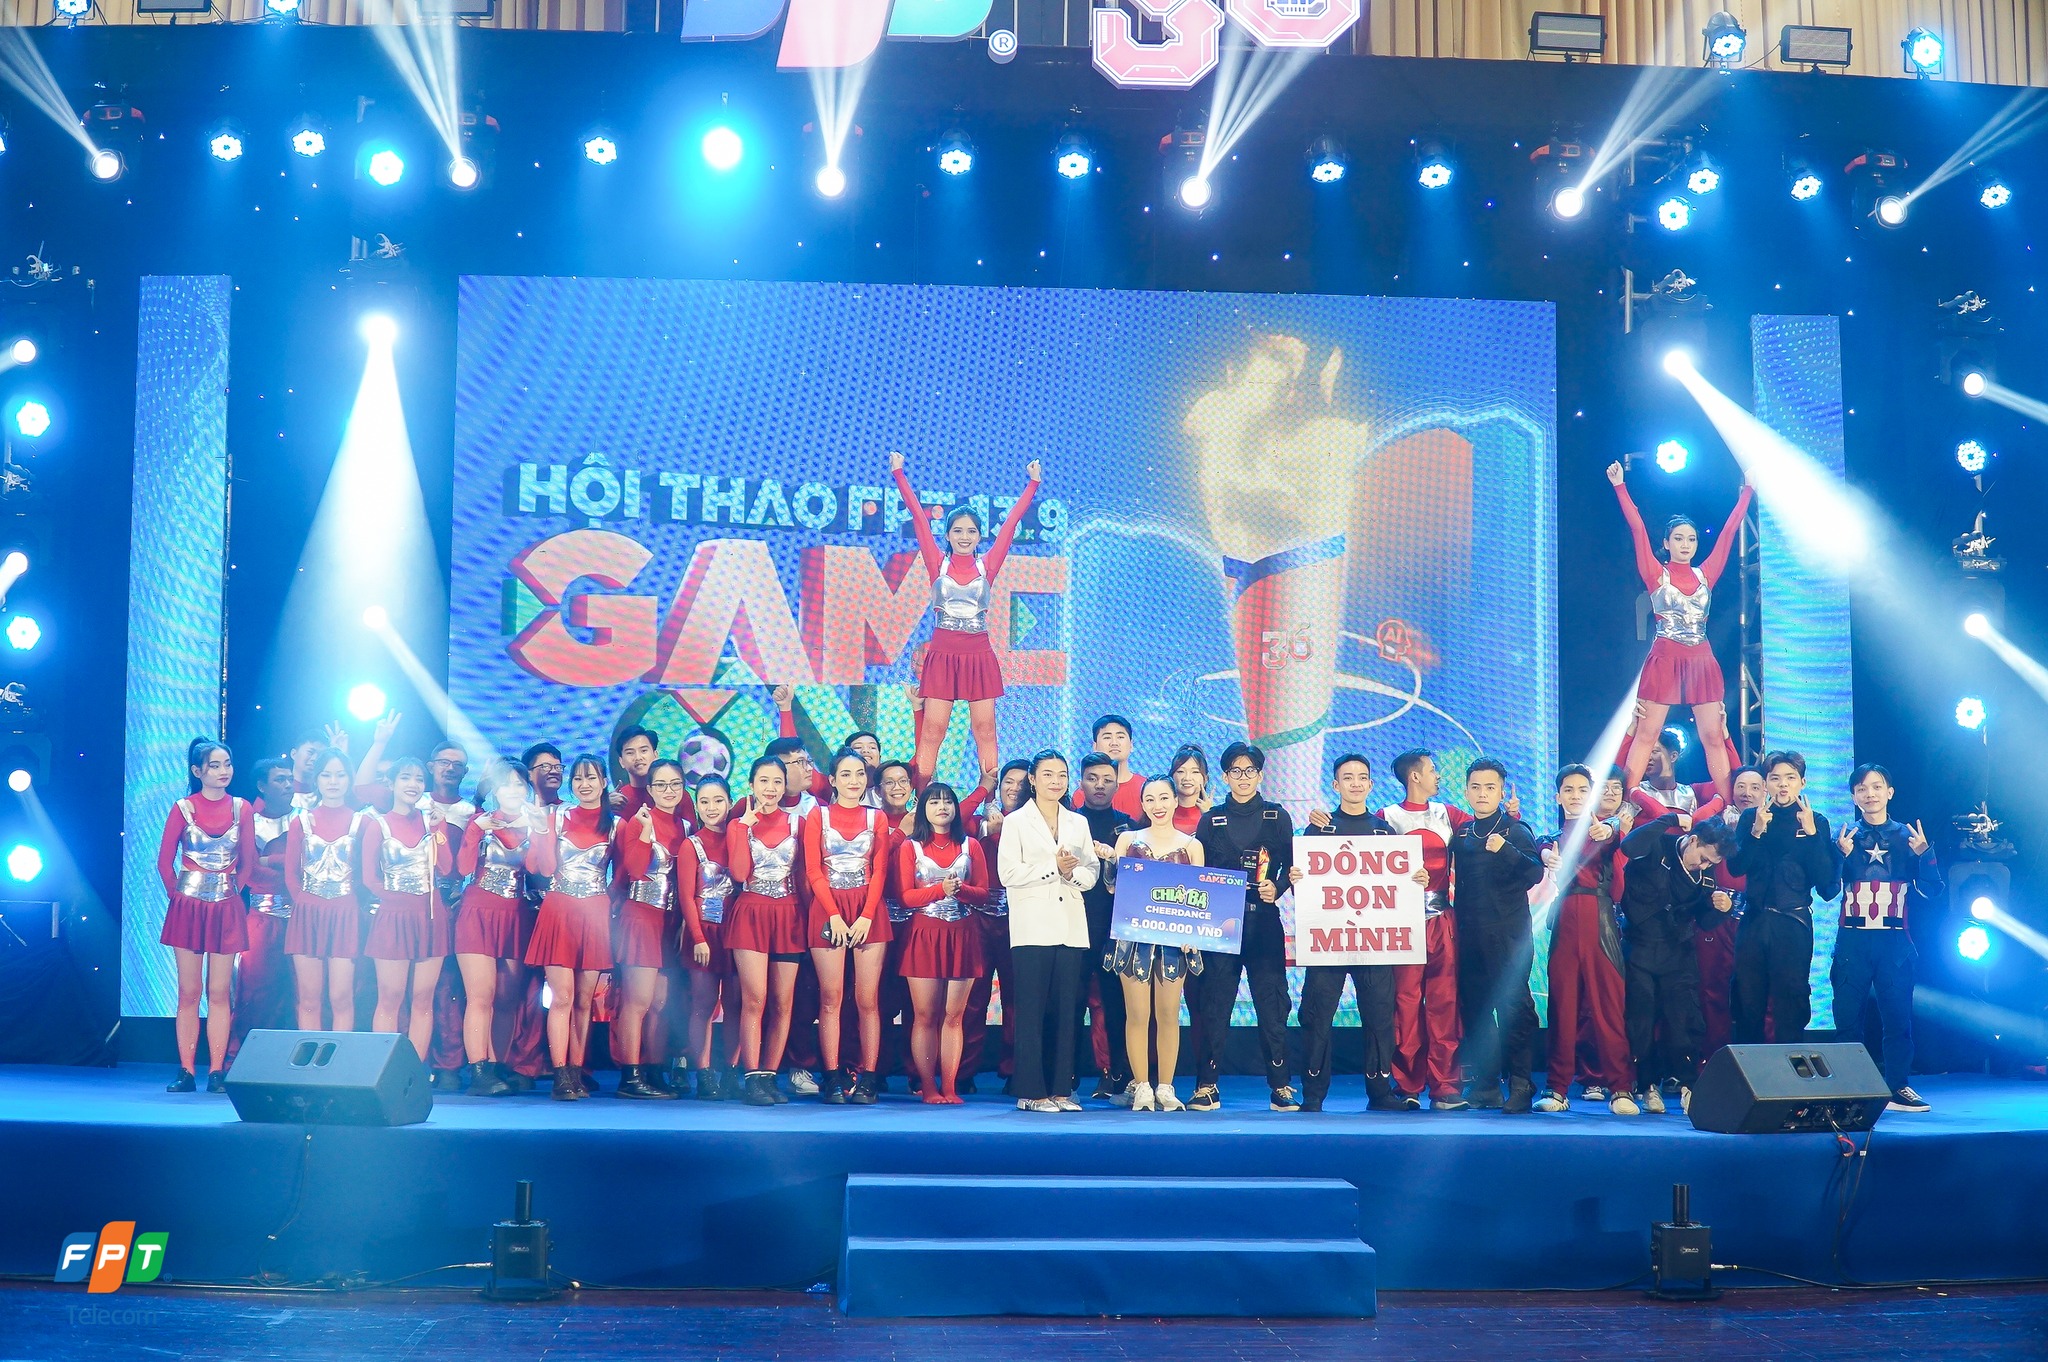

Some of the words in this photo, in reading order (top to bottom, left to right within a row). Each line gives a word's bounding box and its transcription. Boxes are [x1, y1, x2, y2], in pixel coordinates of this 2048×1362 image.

[519, 452, 641, 528] HỘI
[659, 471, 838, 530] THAO
[1308, 840, 1410, 876] ĐỒNG
[1145, 905, 1212, 920] CHEERDANCE
[1322, 885, 1397, 916] BỌN
[1131, 918, 1193, 935] 5.000.000
[1196, 925, 1223, 938] VNĐ
[1310, 920, 1412, 952] MÌNH
